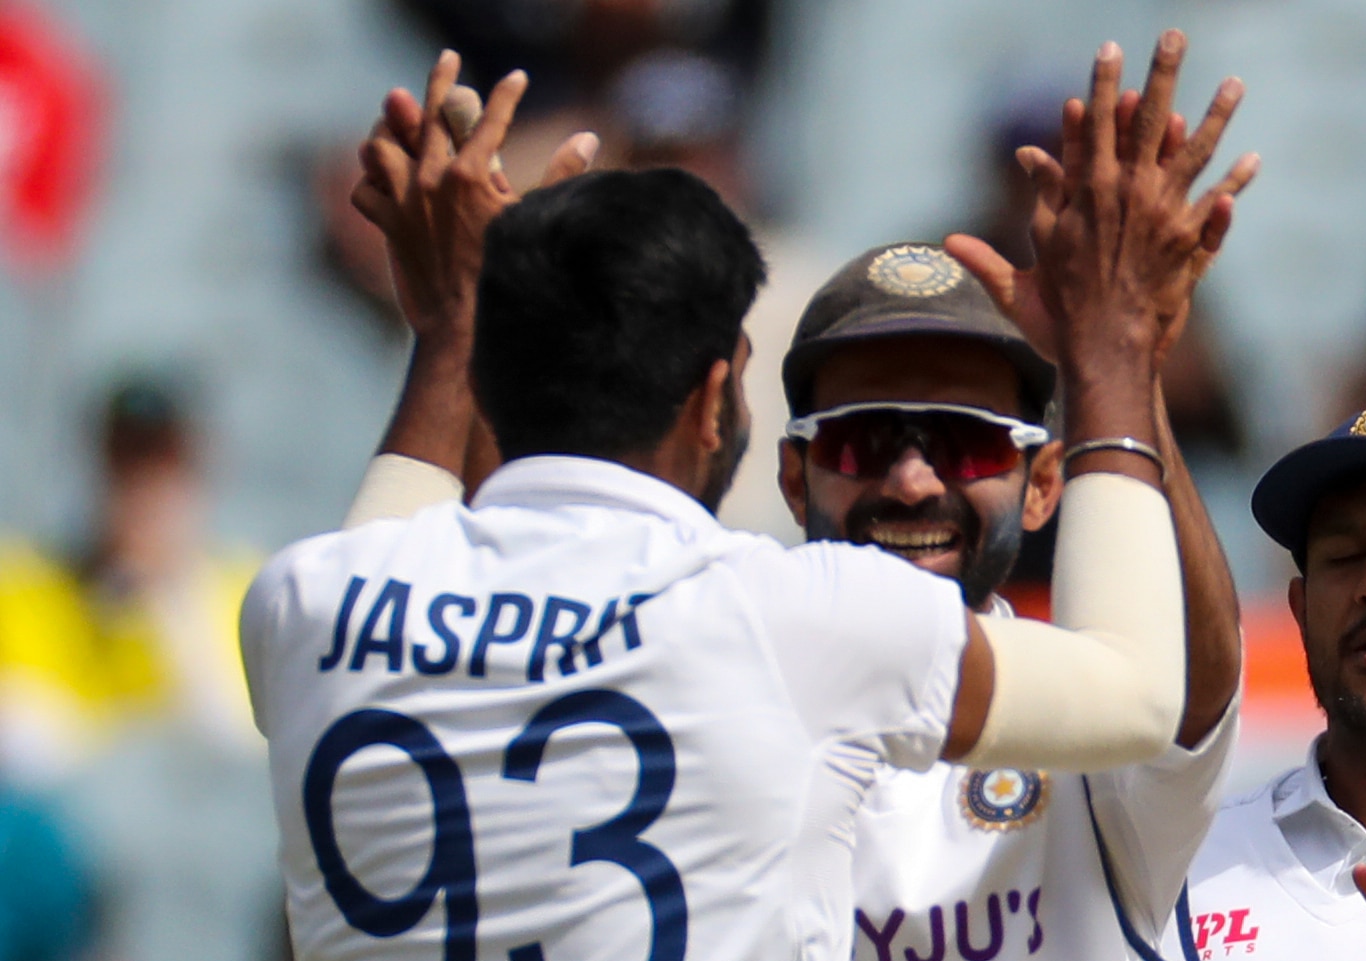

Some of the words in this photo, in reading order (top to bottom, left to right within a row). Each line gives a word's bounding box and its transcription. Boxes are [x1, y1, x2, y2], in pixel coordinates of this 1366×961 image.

[319, 574, 656, 683] JASPRIT
[1190, 907, 1260, 951] PL
[1202, 942, 1256, 961] RTS
